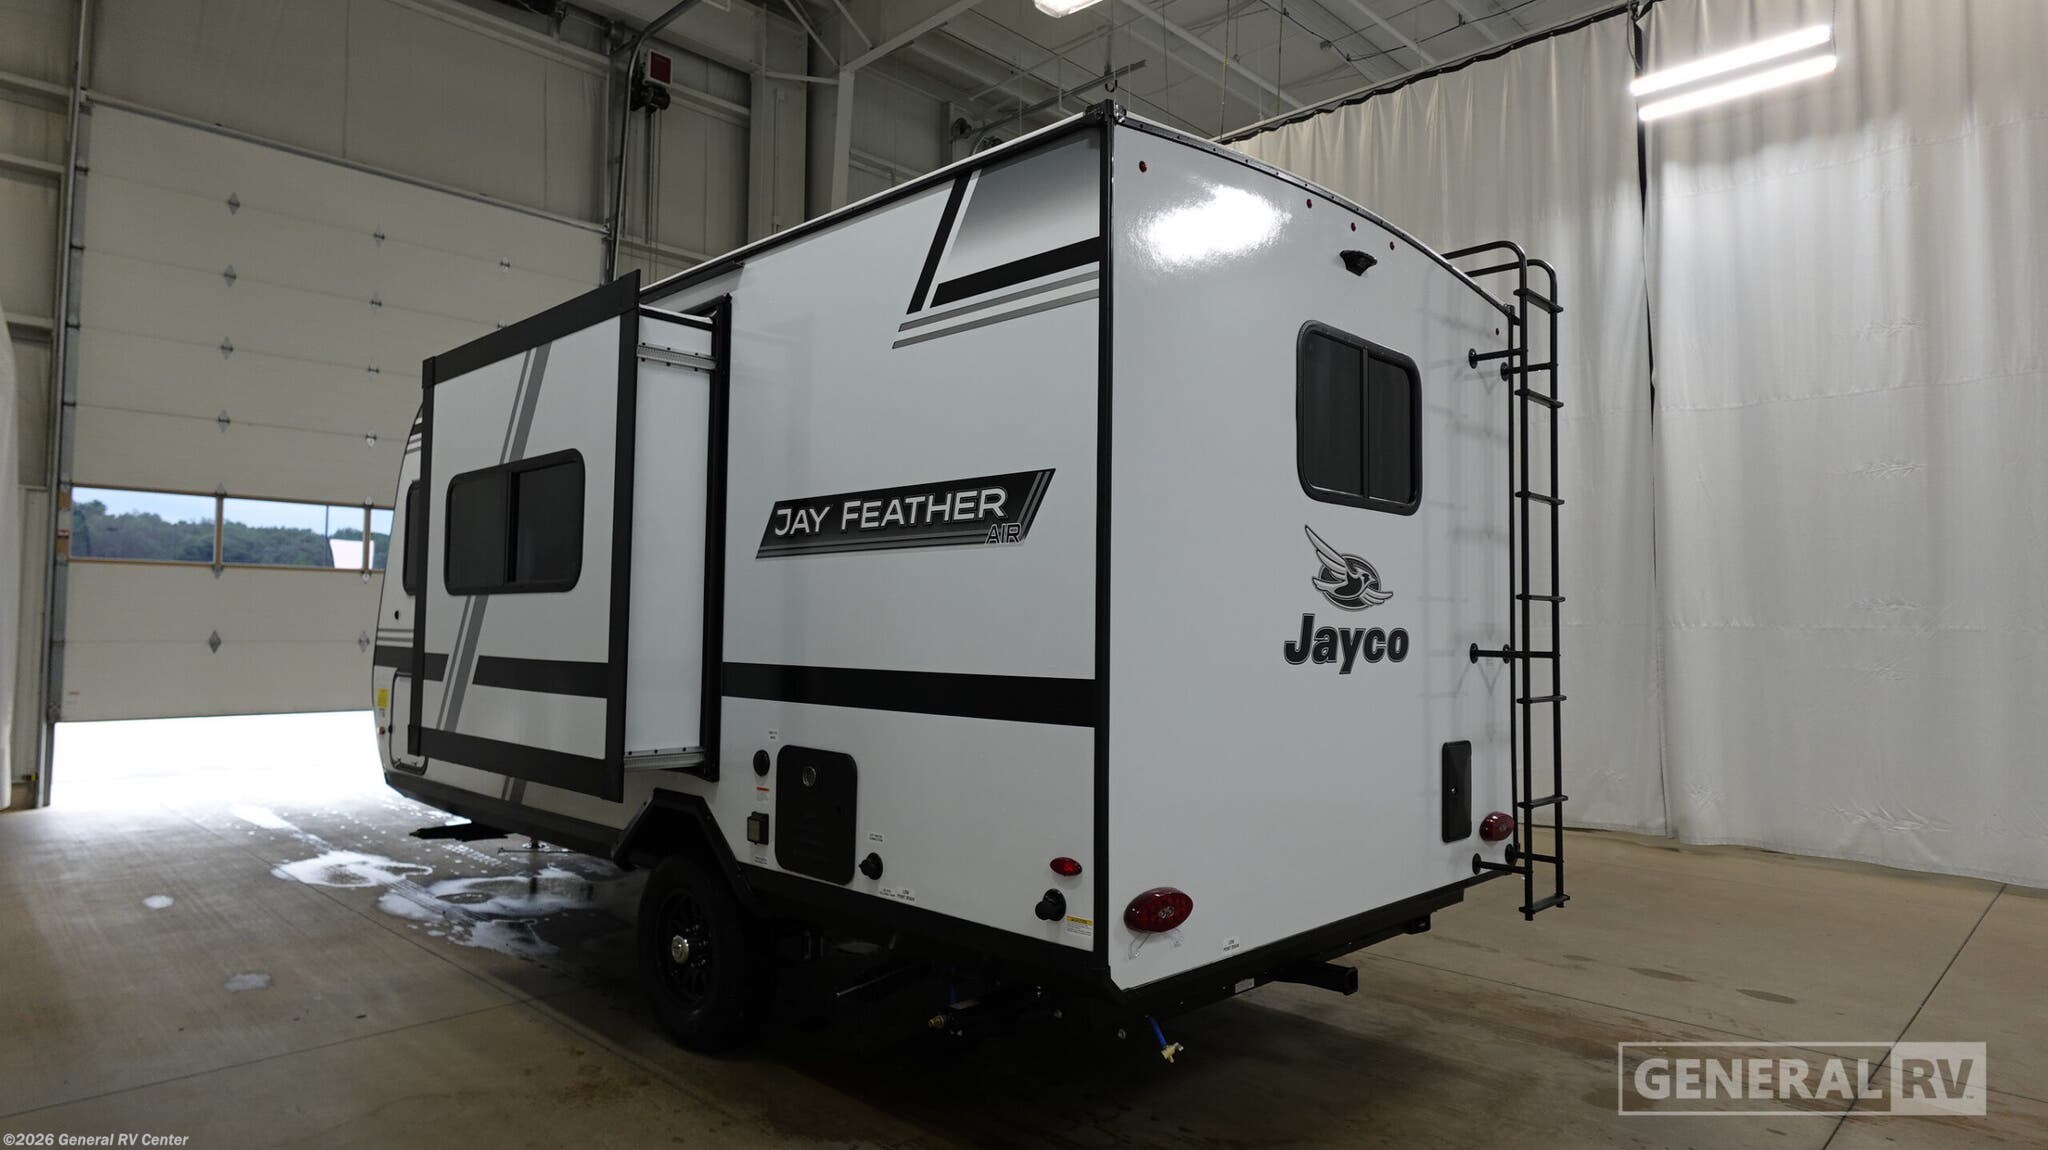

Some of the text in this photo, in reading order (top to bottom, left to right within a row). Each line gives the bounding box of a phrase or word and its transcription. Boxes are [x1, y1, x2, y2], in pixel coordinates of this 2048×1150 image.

[774, 487, 1008, 536] JAY FEATHER
[984, 522, 1025, 545] AIR
[1283, 613, 1409, 675] Jayco
